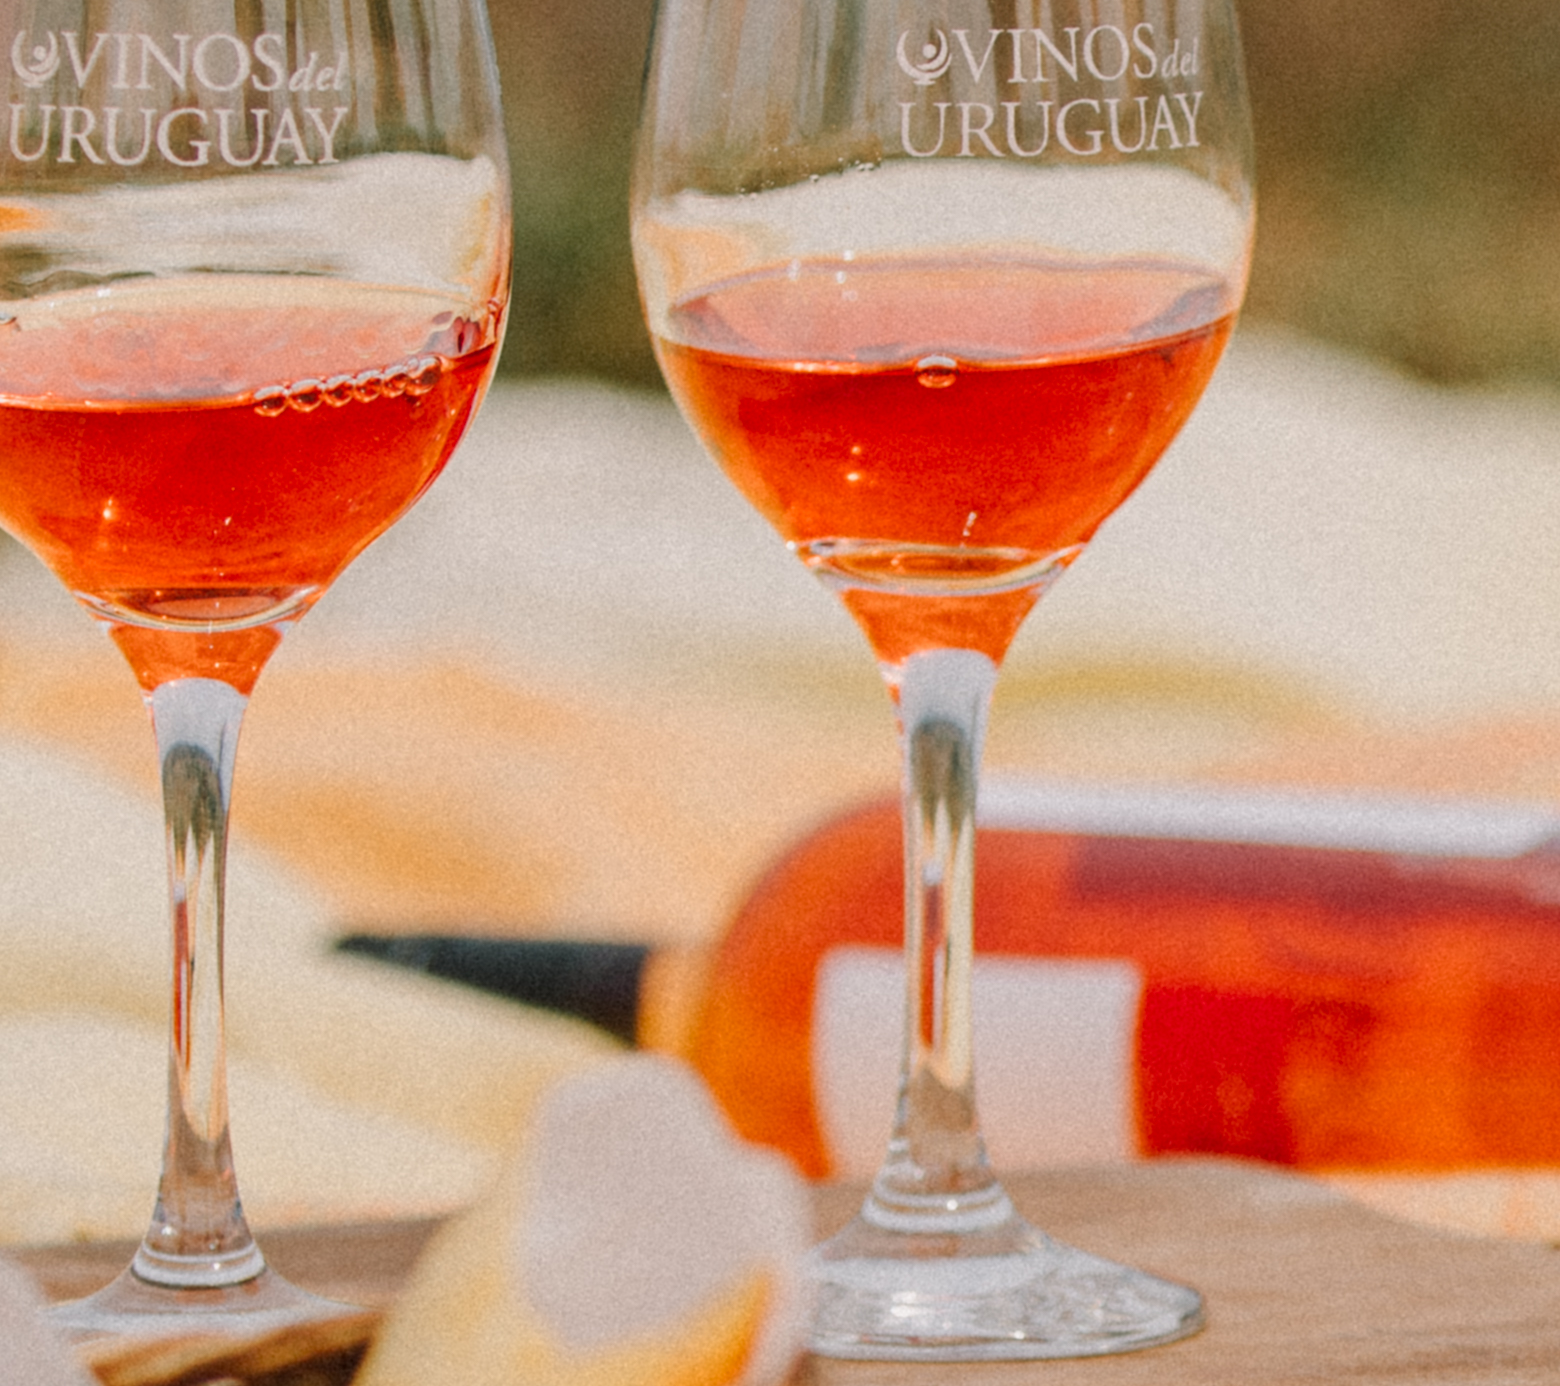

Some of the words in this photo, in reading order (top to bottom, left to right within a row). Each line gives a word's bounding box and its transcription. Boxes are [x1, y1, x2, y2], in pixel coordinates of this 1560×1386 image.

[61, 31, 285, 92] VINOS
[288, 51, 346, 92] del
[951, 23, 1157, 84] VINOS
[1160, 37, 1199, 79] del
[8, 103, 348, 167] URUGUAY
[897, 91, 1204, 158] URUGUAY
